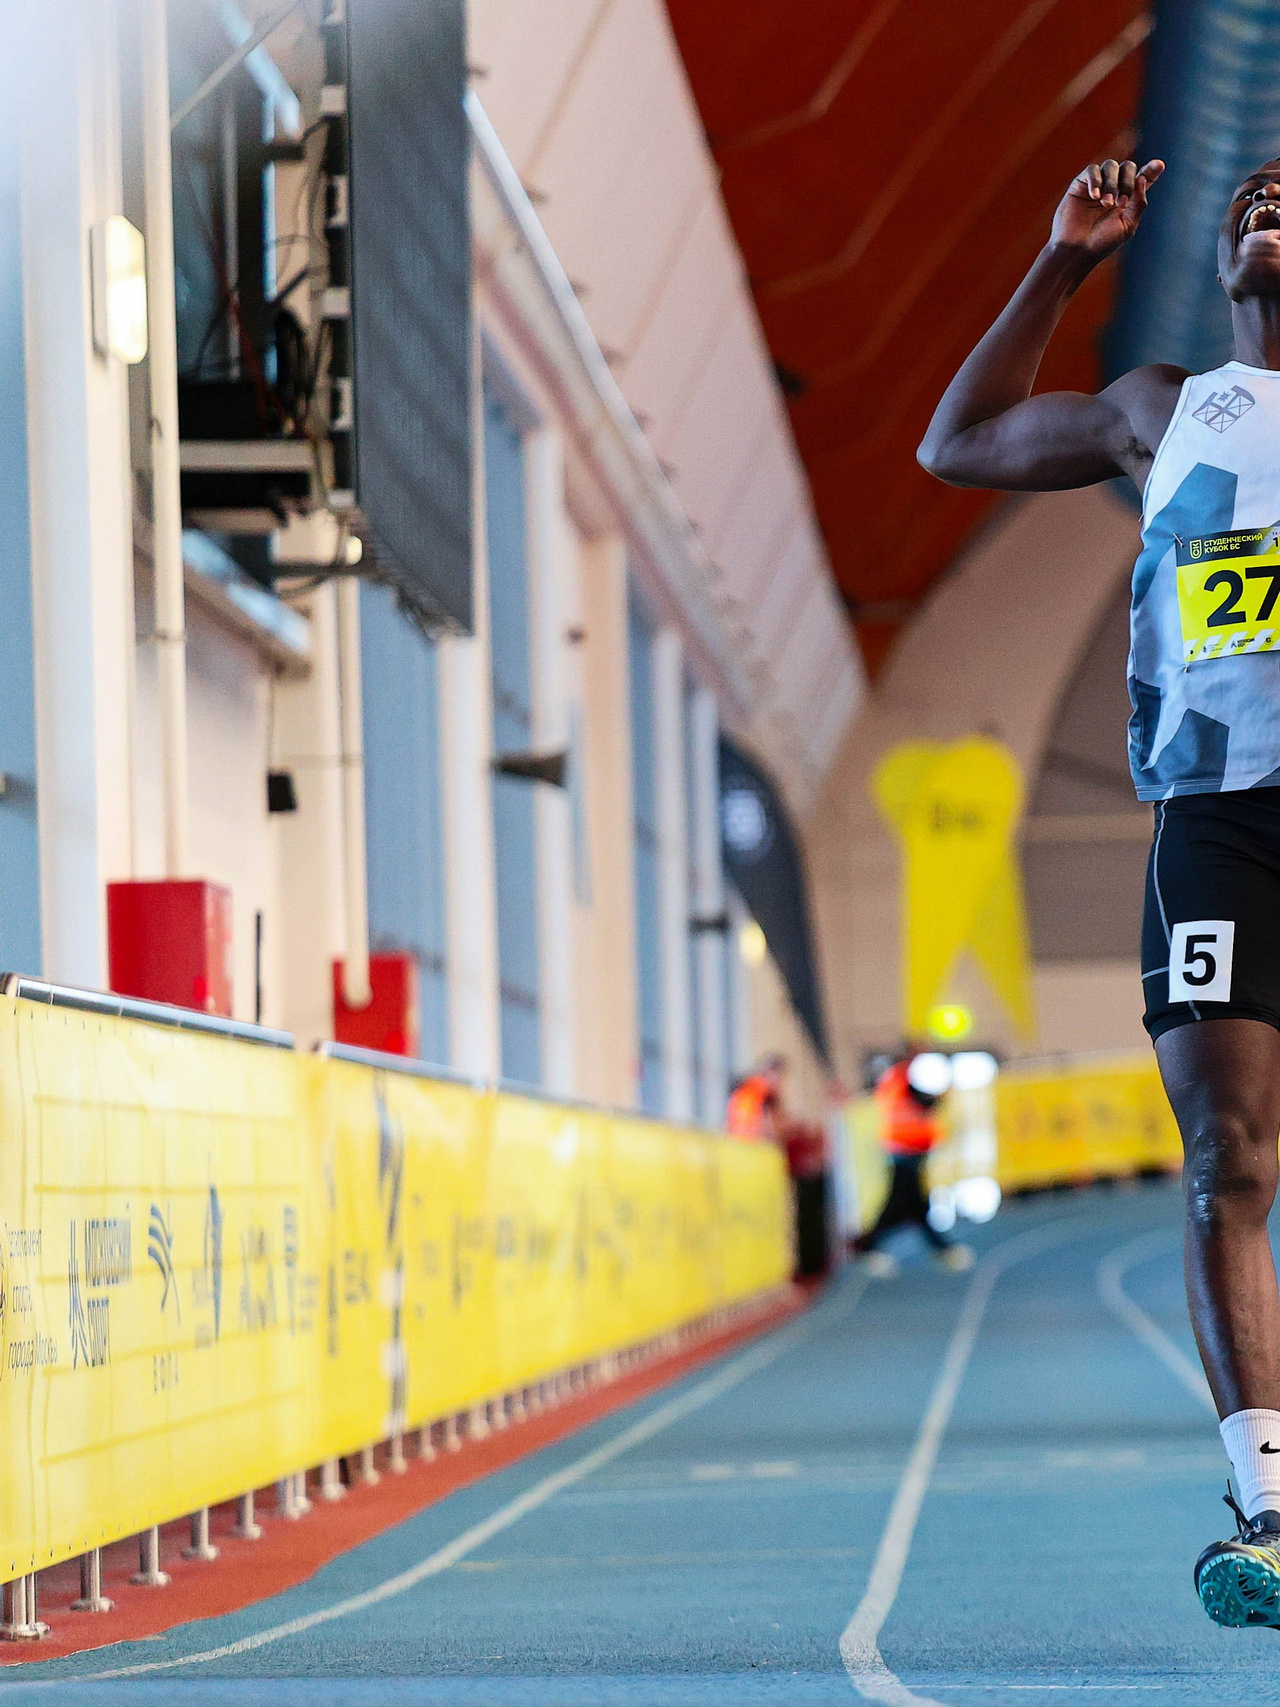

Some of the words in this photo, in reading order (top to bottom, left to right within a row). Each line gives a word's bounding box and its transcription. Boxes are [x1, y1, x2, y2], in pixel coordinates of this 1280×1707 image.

[1204, 532, 1264, 547] СТУДЕНЧЕСКИЙ
[1272, 537, 1280, 547] 1
[1204, 544, 1229, 554] КУБОК
[1230, 542, 1241, 551] БС
[1182, 934, 1217, 986] 5
[8, 1338, 35, 1378] города
